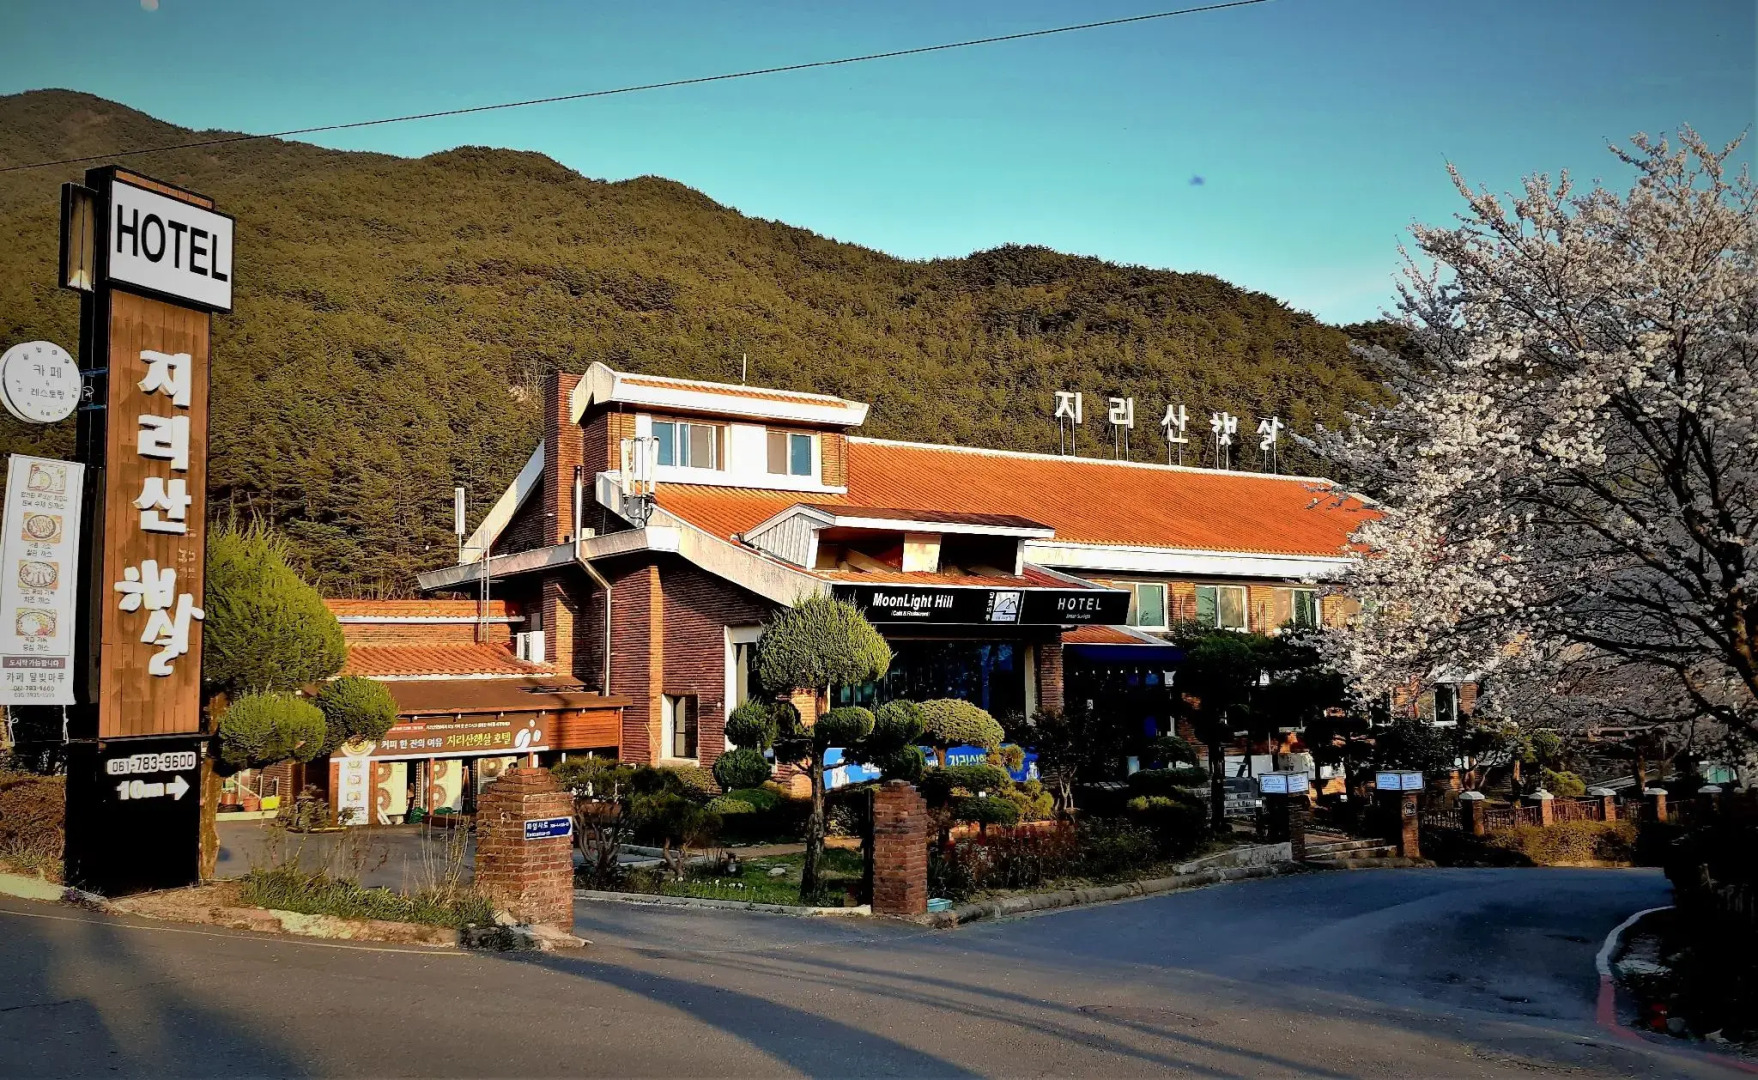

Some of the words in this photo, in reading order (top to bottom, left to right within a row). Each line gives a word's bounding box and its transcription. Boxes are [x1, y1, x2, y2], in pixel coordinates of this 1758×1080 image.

[116, 203, 229, 283] HOTEL
[30, 388, 65, 400] 레스토랑
[872, 592, 933, 611] MoonLight
[934, 594, 954, 608] Hill
[1057, 597, 1103, 610] HOTEL
[6, 671, 24, 683] 카페
[29, 672, 65, 684] 달빛마루
[381, 739, 398, 750] 커피
[399, 738, 408, 749] 한
[409, 738, 425, 749] 잔의
[427, 737, 443, 748] 여유
[493, 731, 511, 745] 호텔
[112, 754, 194, 772] 061-783-9600
[116, 779, 165, 800] 10m
